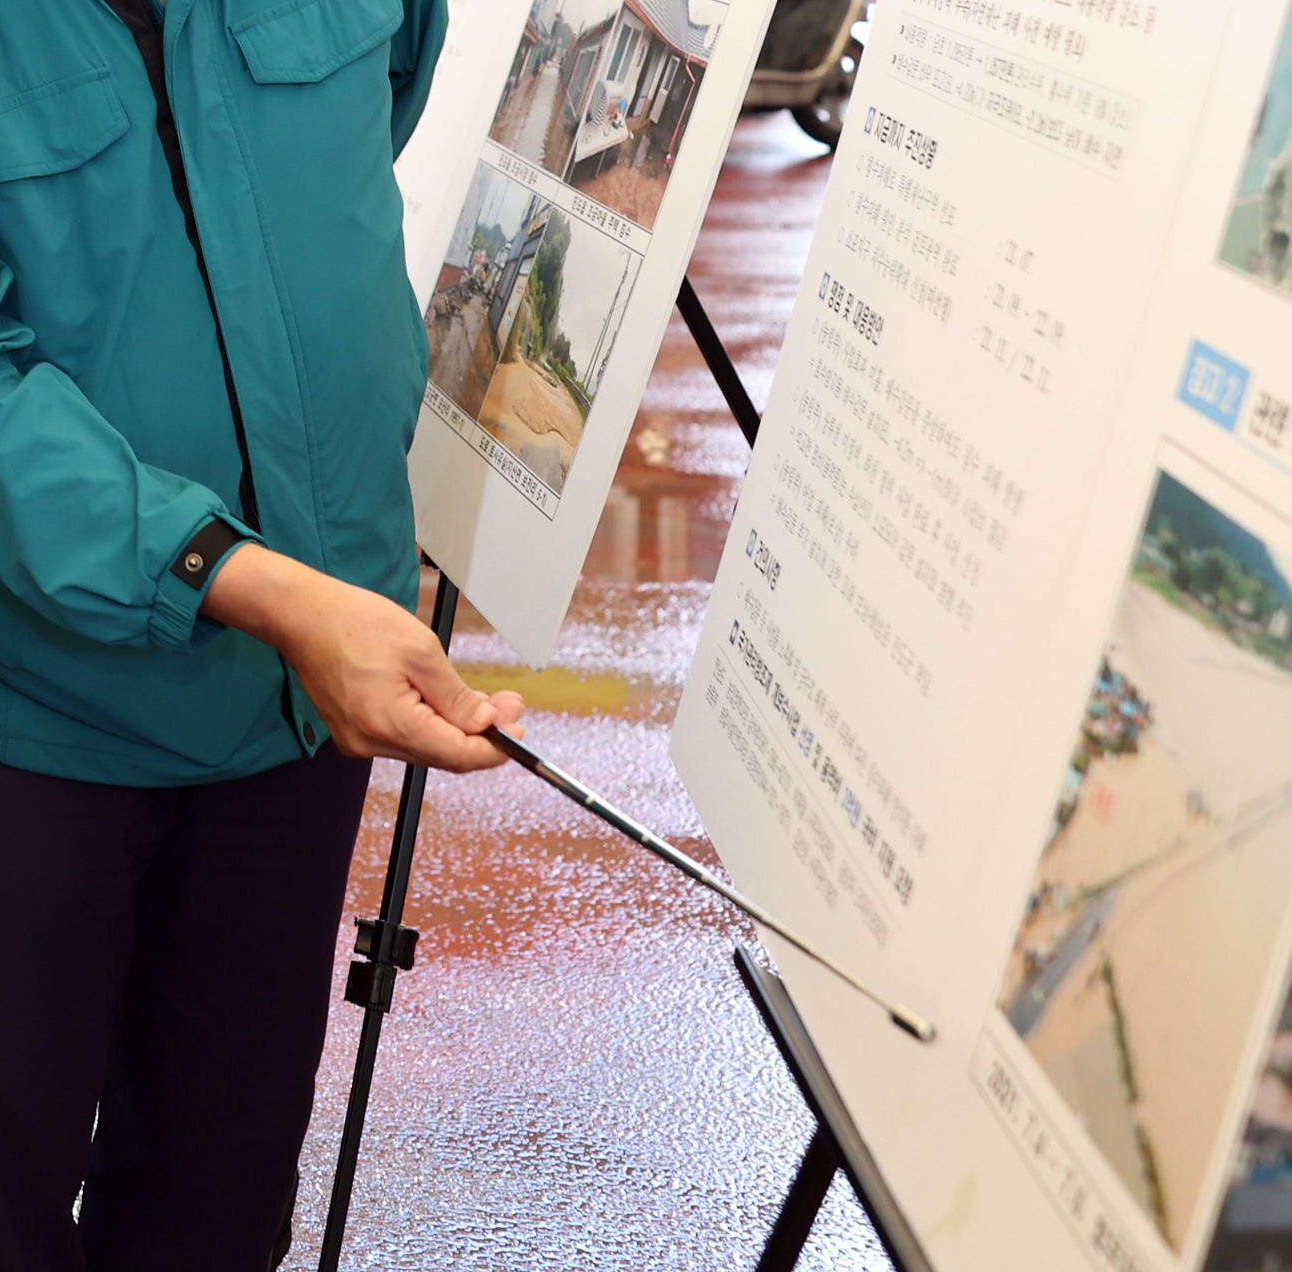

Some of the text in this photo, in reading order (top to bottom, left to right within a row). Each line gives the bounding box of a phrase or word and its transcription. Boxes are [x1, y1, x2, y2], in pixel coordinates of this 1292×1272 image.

[872, 110, 939, 170] 지금까지 추진상황
[843, 226, 871, 266] 소포지구
[826, 278, 885, 348] 쟁점 및 대응방안
[752, 536, 782, 594] 건의사항
